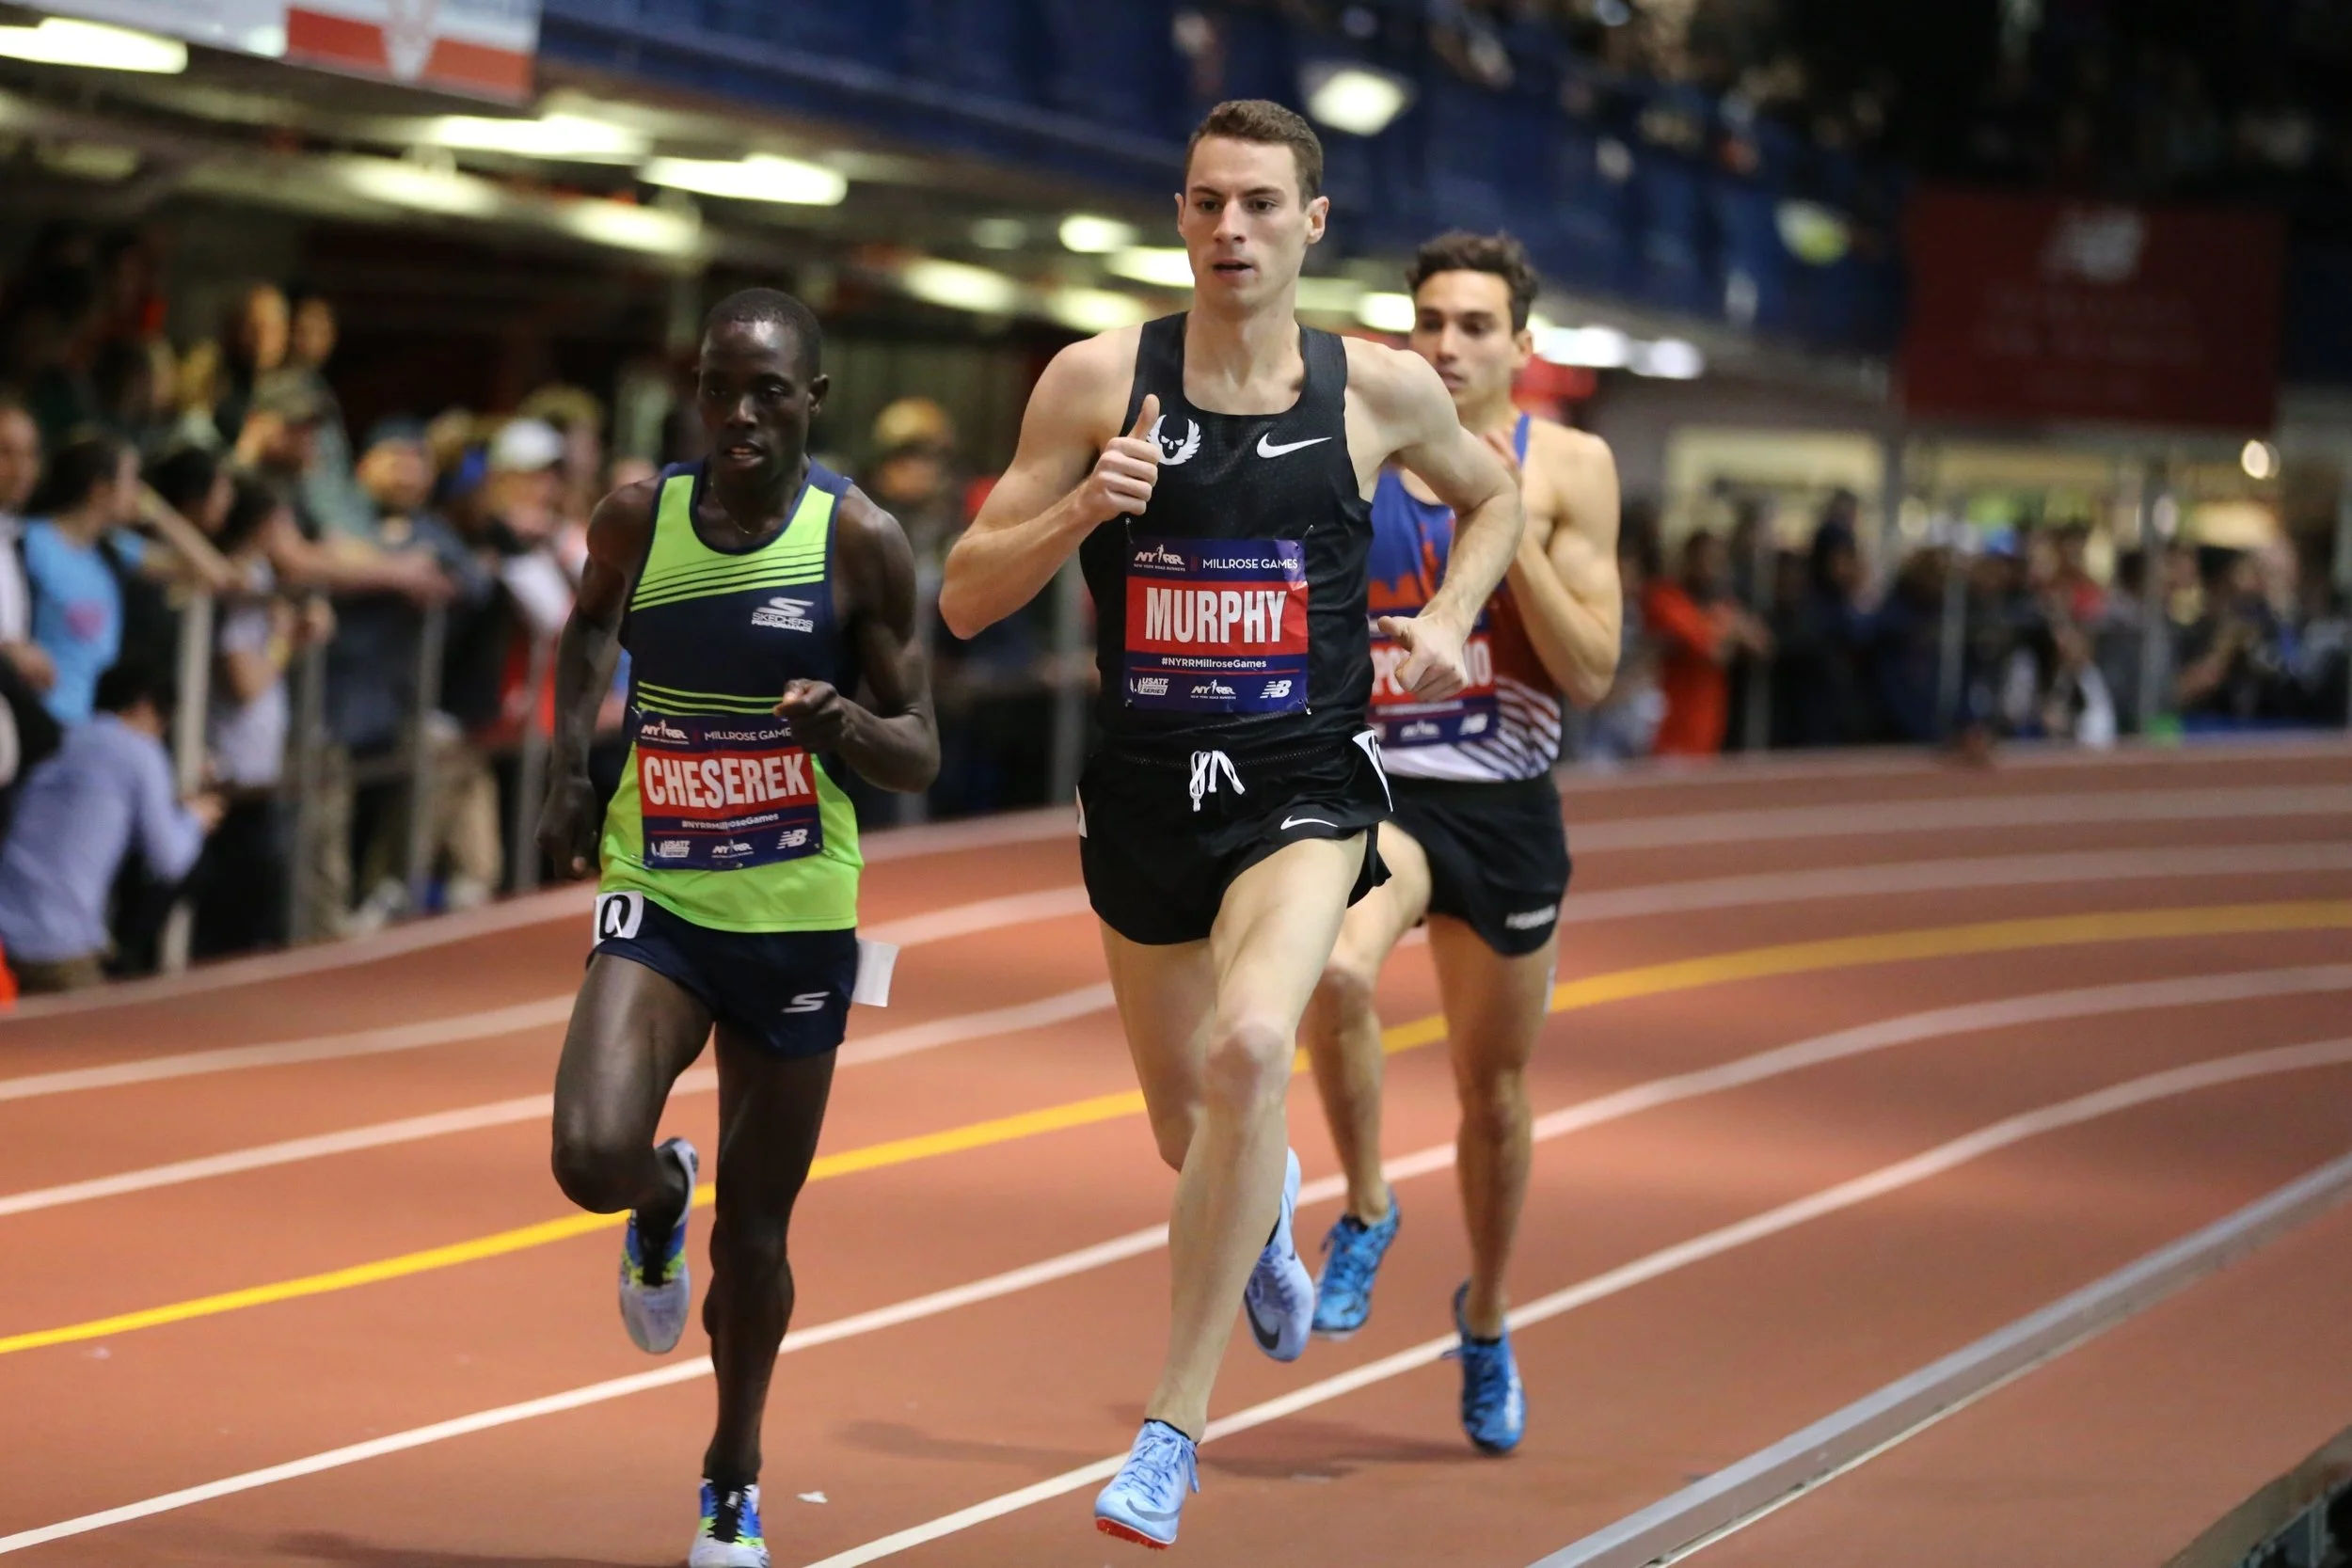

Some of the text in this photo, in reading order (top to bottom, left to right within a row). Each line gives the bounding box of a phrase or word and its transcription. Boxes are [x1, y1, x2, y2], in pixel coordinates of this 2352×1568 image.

[1202, 558, 1298, 569] MILLROSE GAMES
[752, 611, 814, 627] SKECHERS
[1145, 586, 1287, 643] MURPHY
[1161, 657, 1267, 668] #NYRRMillroseGames
[705, 727, 791, 741] MILLROSE GAME
[644, 753, 810, 809] CHESEREK
[681, 814, 779, 830] #NYRRMillroseGames
